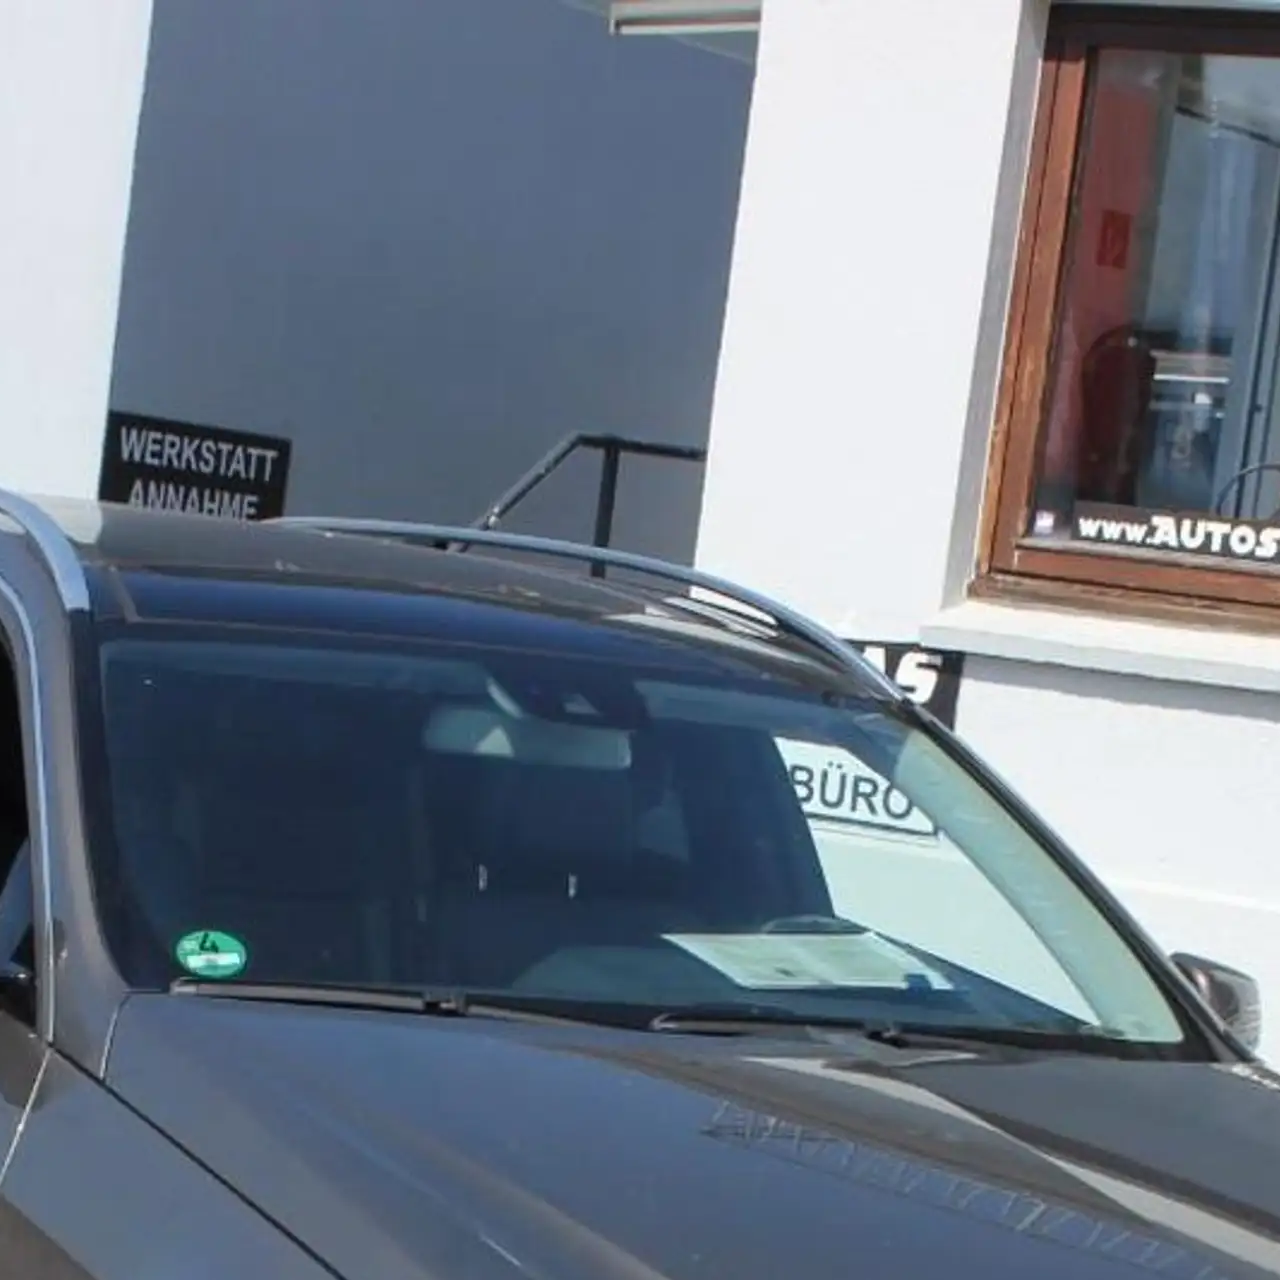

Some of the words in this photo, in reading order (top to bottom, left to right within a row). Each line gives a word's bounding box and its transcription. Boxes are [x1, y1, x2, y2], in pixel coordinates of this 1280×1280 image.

[120, 425, 279, 482] WERKSTATT
[128, 479, 260, 522] ANNAHME
[790, 760, 913, 820] BÜRO
[199, 931, 219, 953] 4
